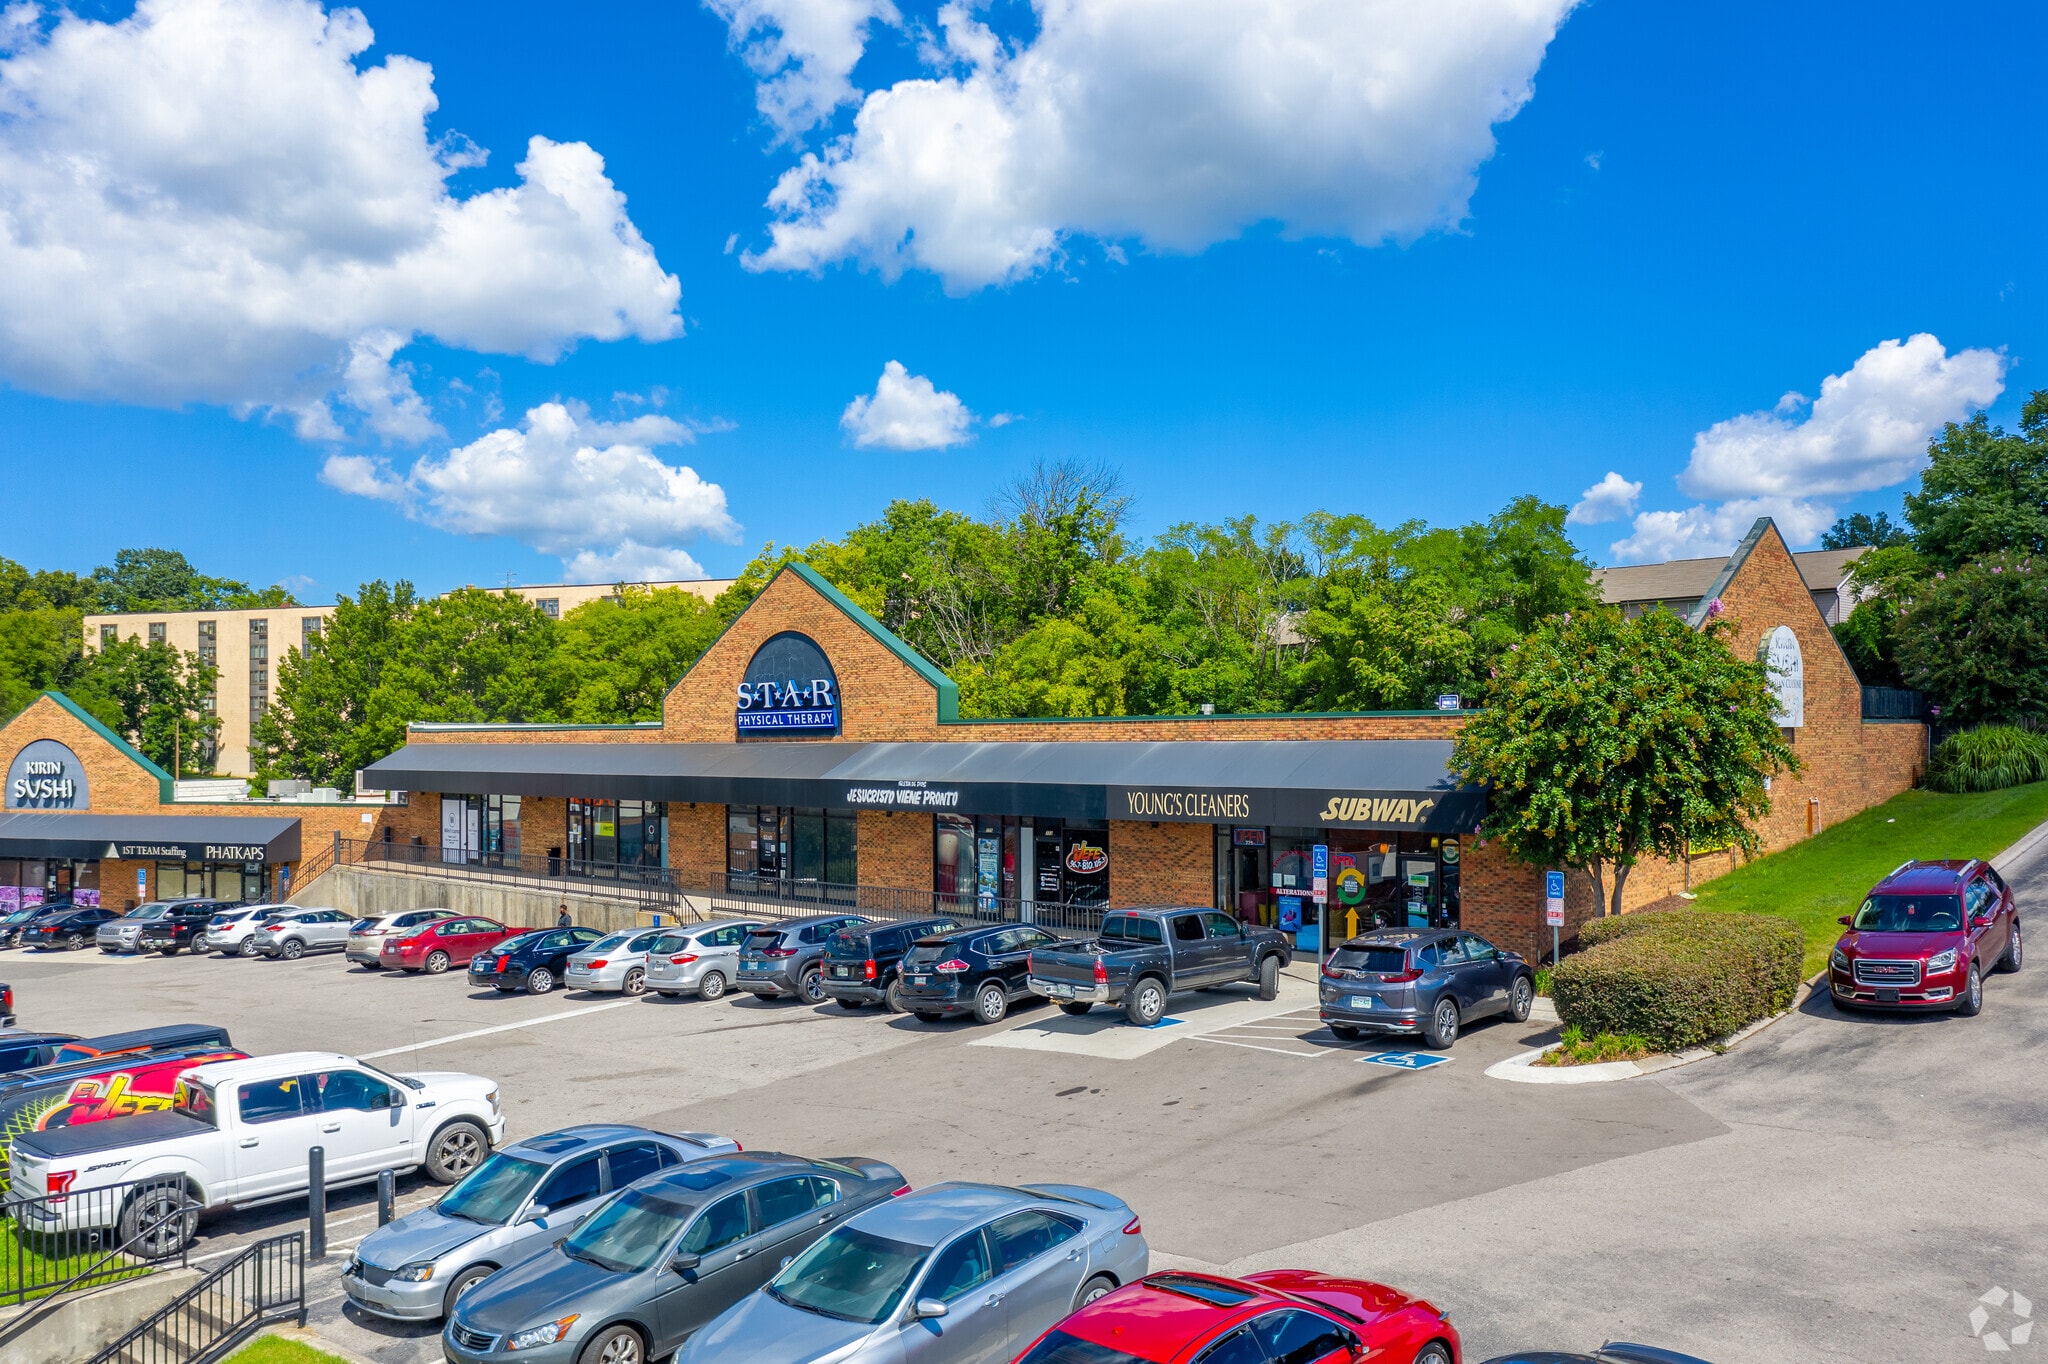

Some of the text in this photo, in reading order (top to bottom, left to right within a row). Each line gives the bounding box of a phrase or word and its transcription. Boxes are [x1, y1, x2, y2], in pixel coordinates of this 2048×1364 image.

[738, 713, 833, 725] PHYSICAL THERAPY
[26, 761, 61, 774] KIRIN
[14, 778, 73, 798] SUSHI
[846, 788, 958, 806] JESUCRISTO VIENE PRONTO
[1127, 791, 1249, 818] YOUNG'S CLEANERS
[1320, 797, 1435, 823] SUBWAY
[122, 846, 186, 858] 1ST TEAM Staffing
[206, 846, 264, 860] PHATKAPS
[1332, 855, 1355, 866] OPEN
[1276, 888, 1314, 897] ALTERATIONS
[68, 1083, 107, 1105] EL
[84, 1159, 132, 1173] SPORT
